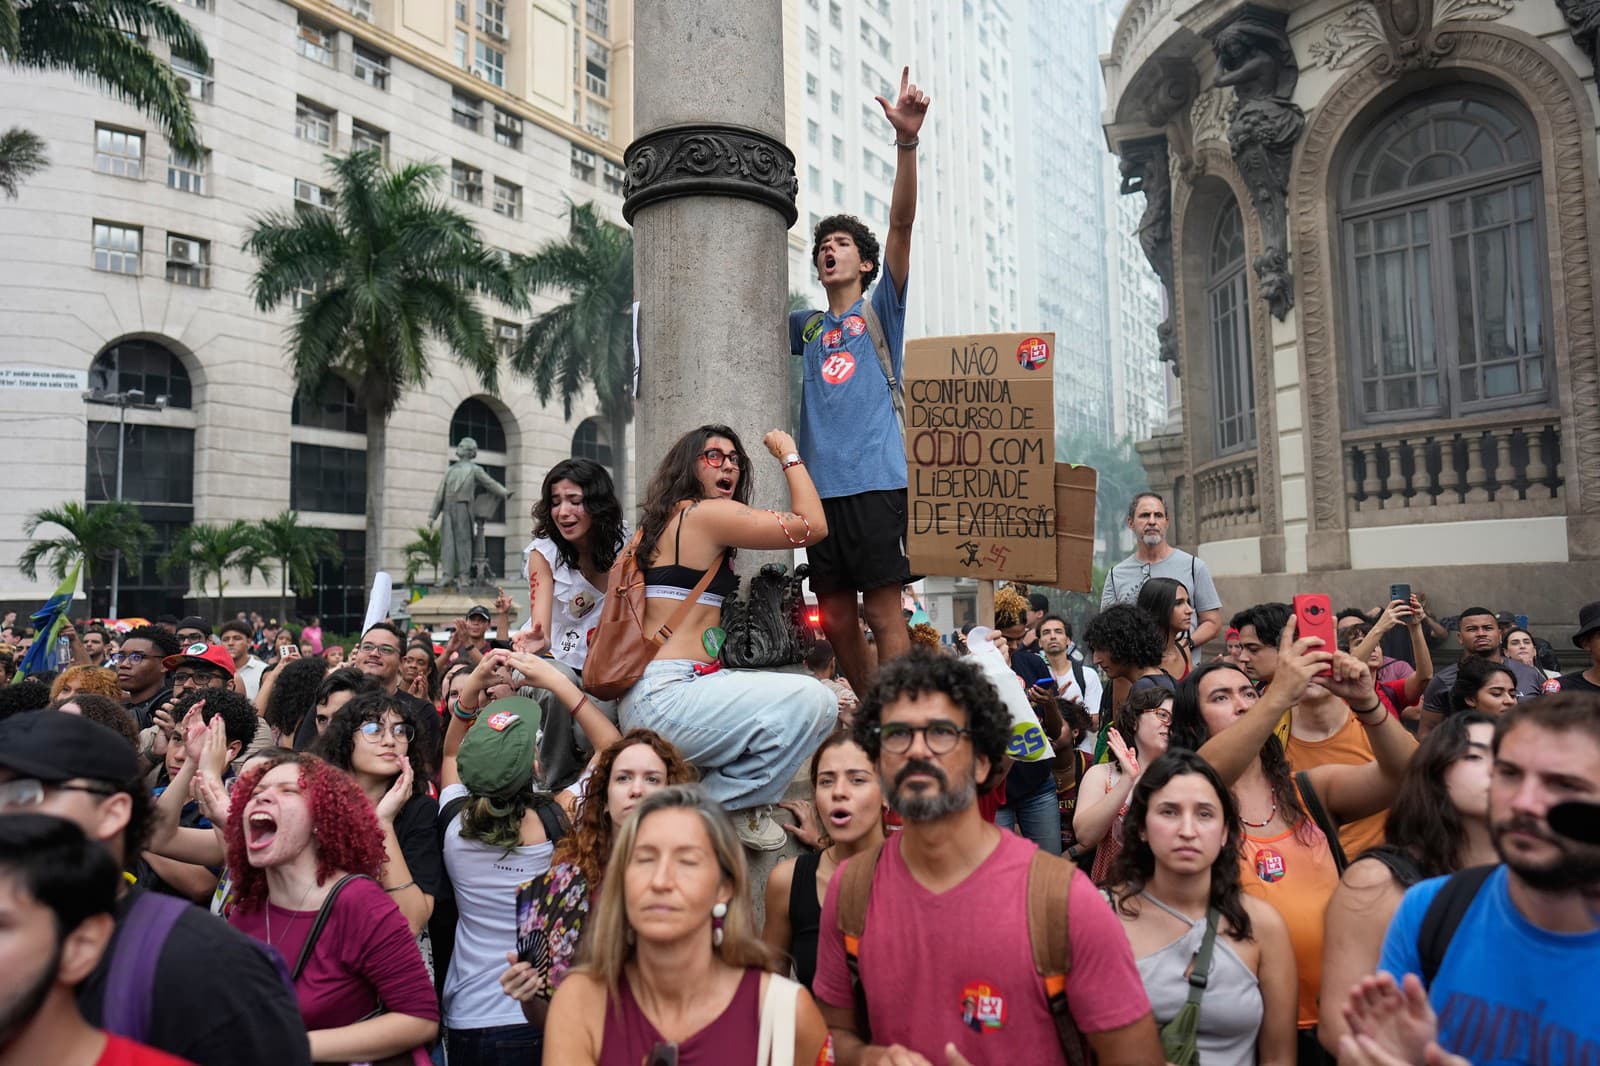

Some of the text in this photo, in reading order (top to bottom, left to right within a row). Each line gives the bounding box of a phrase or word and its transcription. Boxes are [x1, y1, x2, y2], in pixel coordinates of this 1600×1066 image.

[950, 343, 998, 376] NÃO
[911, 378, 1012, 404] CONFUNDA
[1010, 407, 1035, 430] DE
[990, 438, 1044, 465] COM
[914, 501, 1057, 538] DE EXPRESSÃO
[1008, 727, 1044, 756] 55
